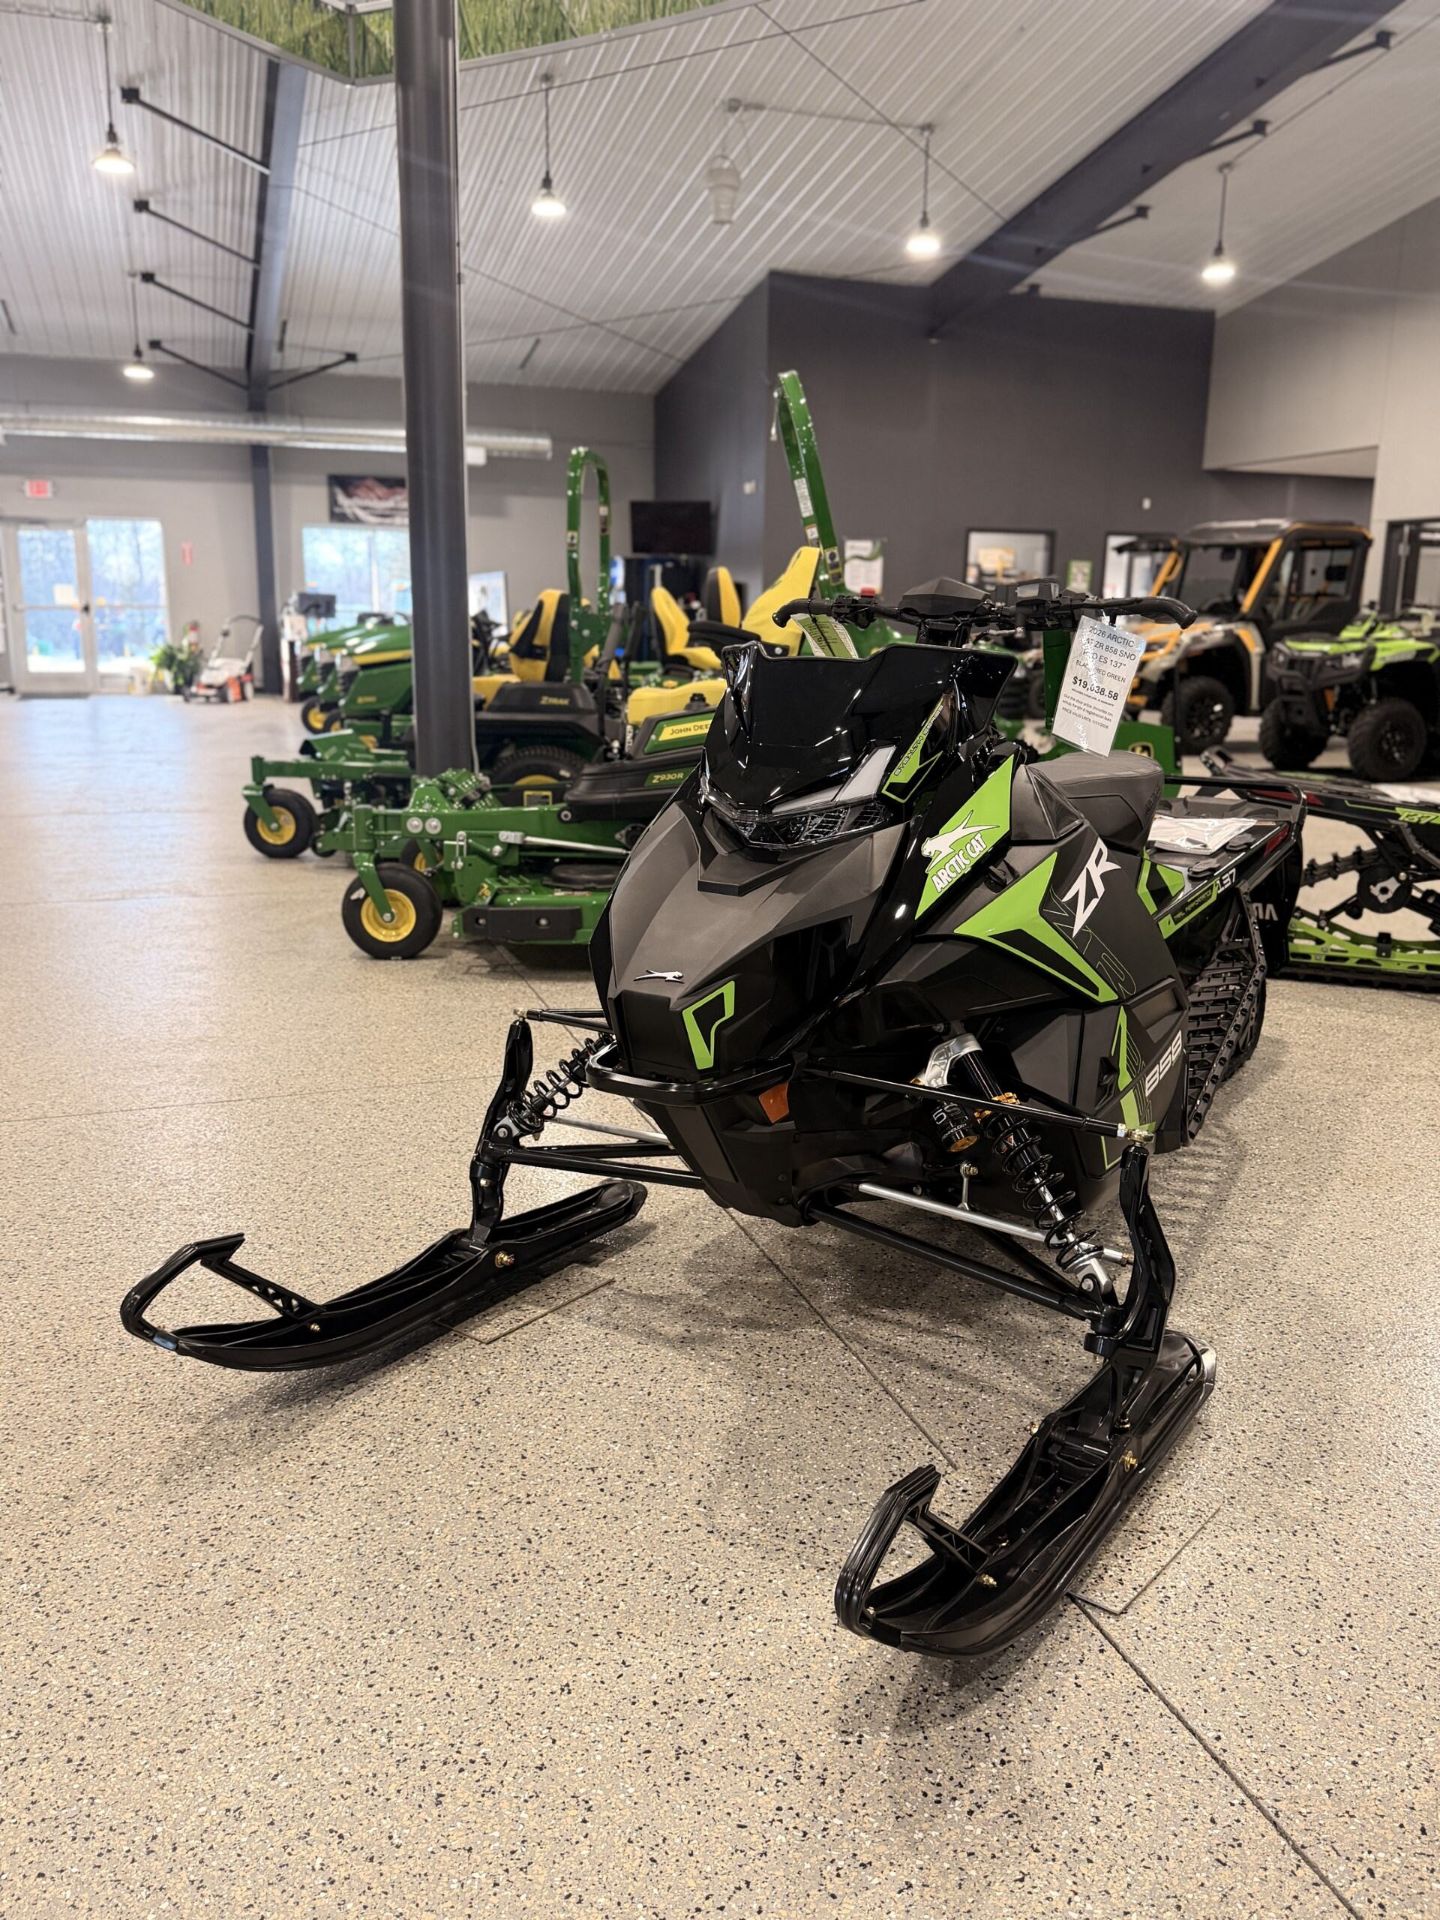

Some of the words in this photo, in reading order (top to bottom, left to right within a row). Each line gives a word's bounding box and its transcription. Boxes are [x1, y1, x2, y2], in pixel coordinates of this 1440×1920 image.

[1089, 626, 1106, 638] 2026
[1107, 633, 1135, 648] ARCTIC
[1094, 640, 1104, 650] ZR
[1104, 645, 1118, 655] 858
[1118, 649, 1136, 661] SNO
[1099, 655, 1109, 665] ES
[1106, 671, 1126, 683] GREEN
[670, 727, 692, 735] JOHN
[931, 849, 971, 894] ARCTIC
[964, 832, 987, 858] CAT
[1061, 837, 1121, 938] ZR
[1216, 868, 1237, 894] 137
[1145, 1029, 1182, 1097] 858
